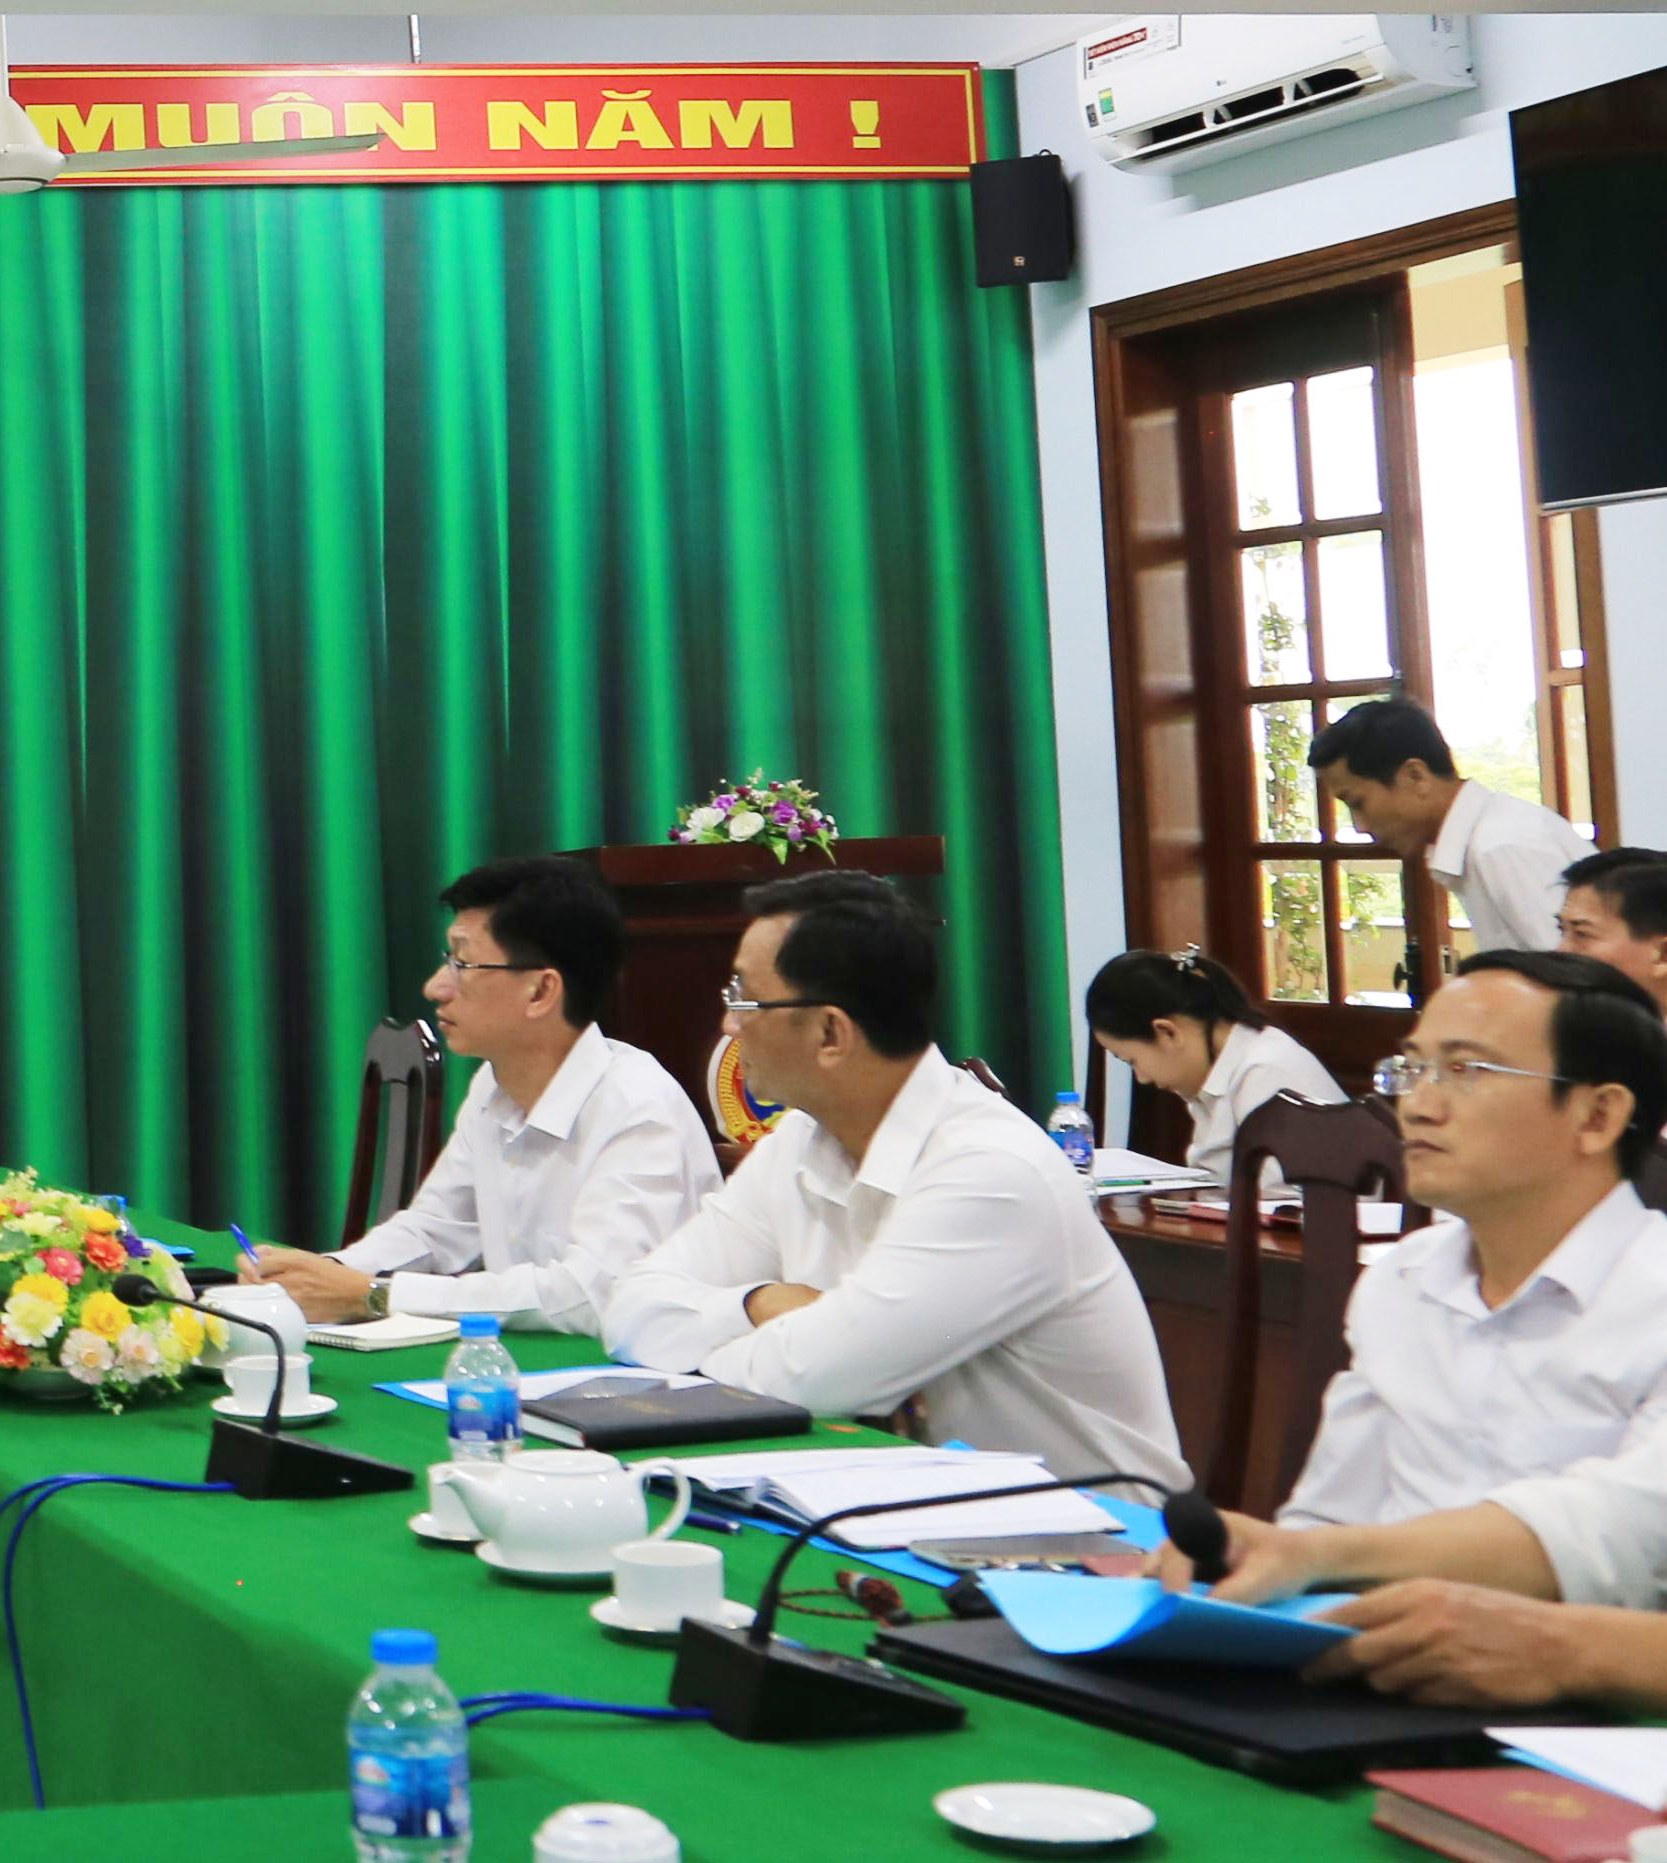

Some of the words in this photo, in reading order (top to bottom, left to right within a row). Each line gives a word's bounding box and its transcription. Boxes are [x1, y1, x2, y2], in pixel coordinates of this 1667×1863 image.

[24, 91, 437, 153] MUÔN
[487, 90, 793, 150] NĂM
[851, 101, 880, 148] !
